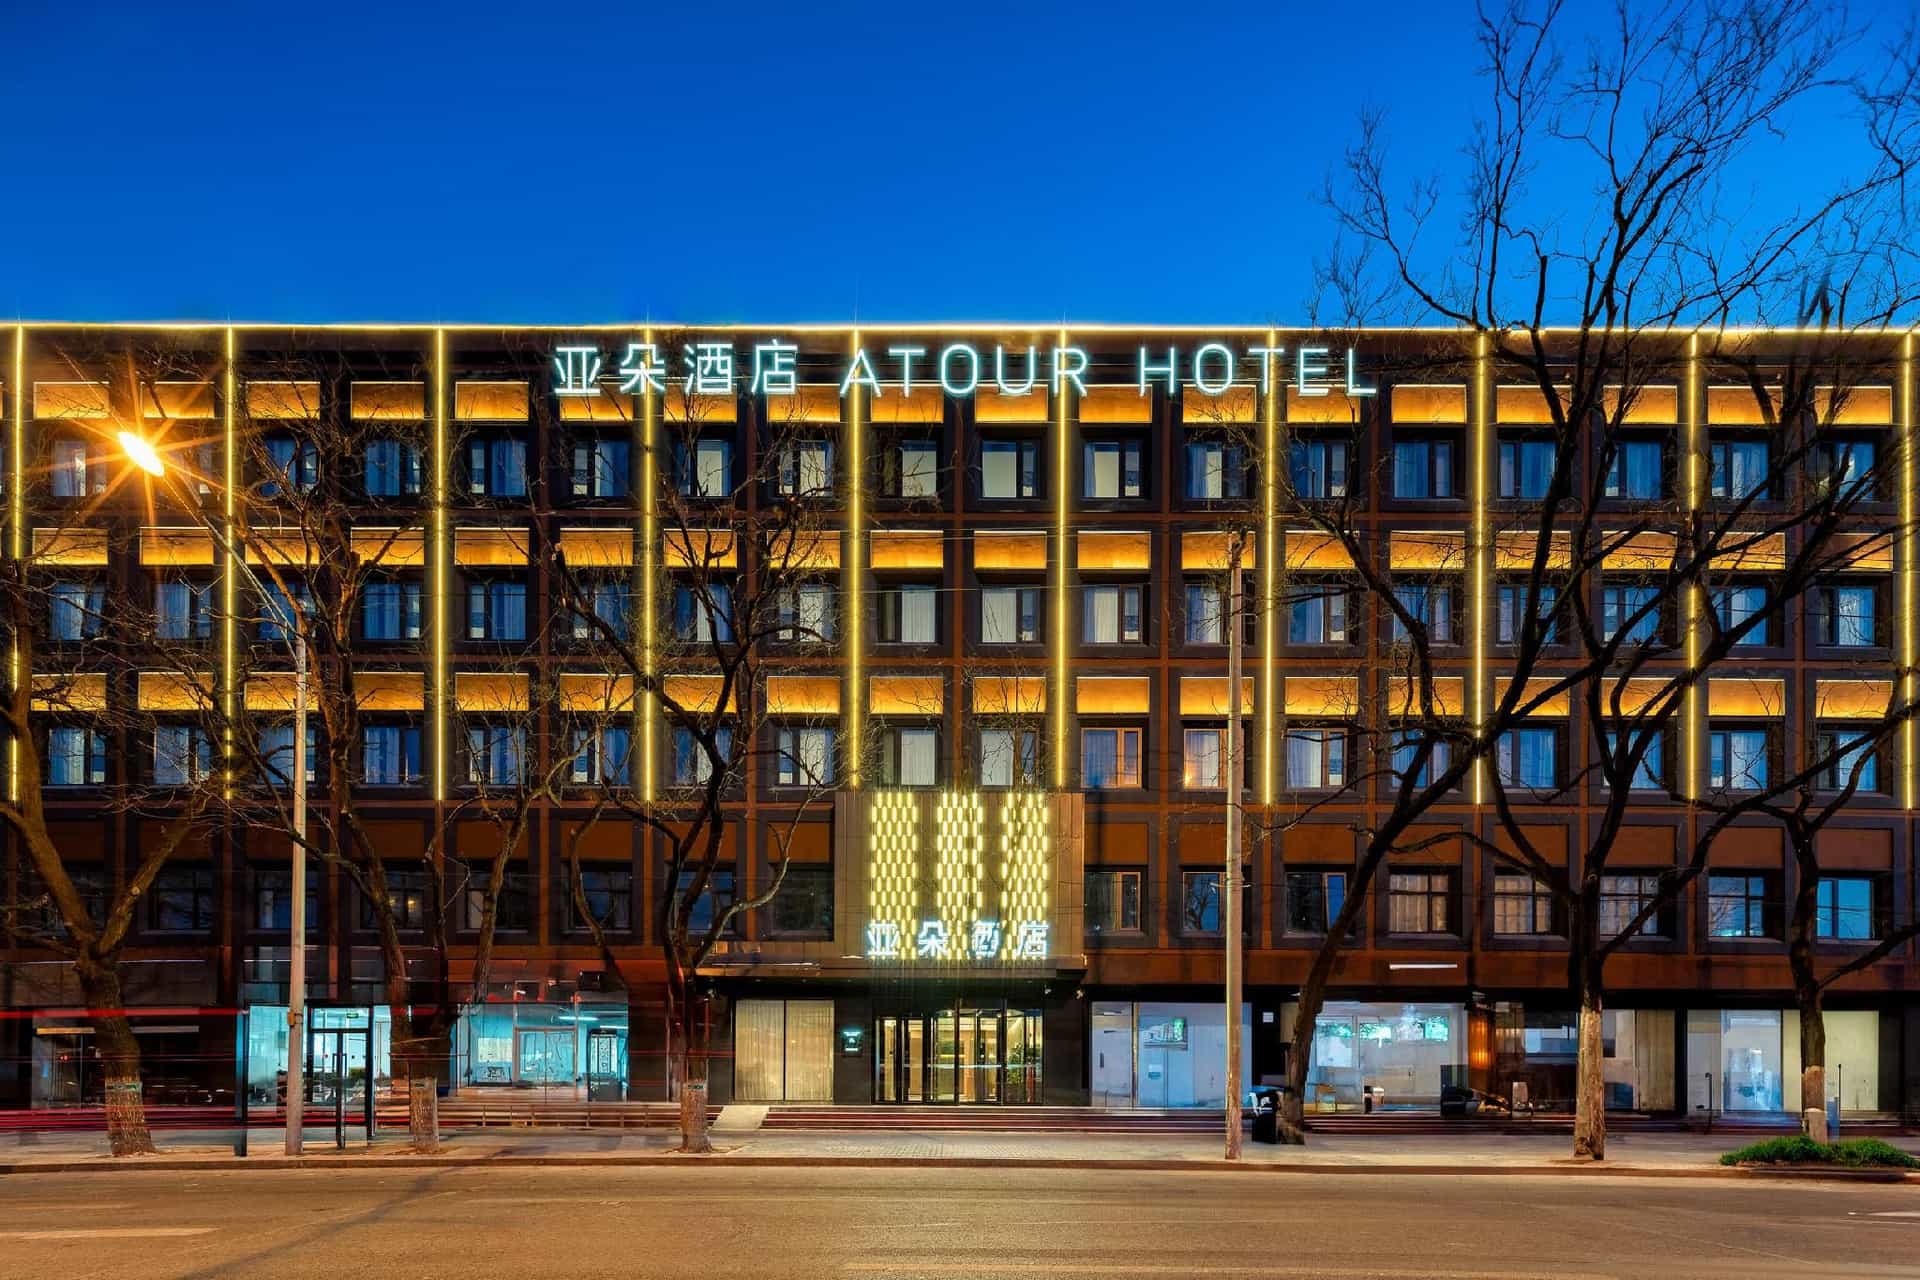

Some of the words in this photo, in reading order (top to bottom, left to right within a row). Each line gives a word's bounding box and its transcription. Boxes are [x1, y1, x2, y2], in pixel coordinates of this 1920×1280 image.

[554, 339, 798, 395] 亚朵酒店
[839, 343, 1088, 398] ATOUR
[1139, 343, 1377, 397] HOTEL
